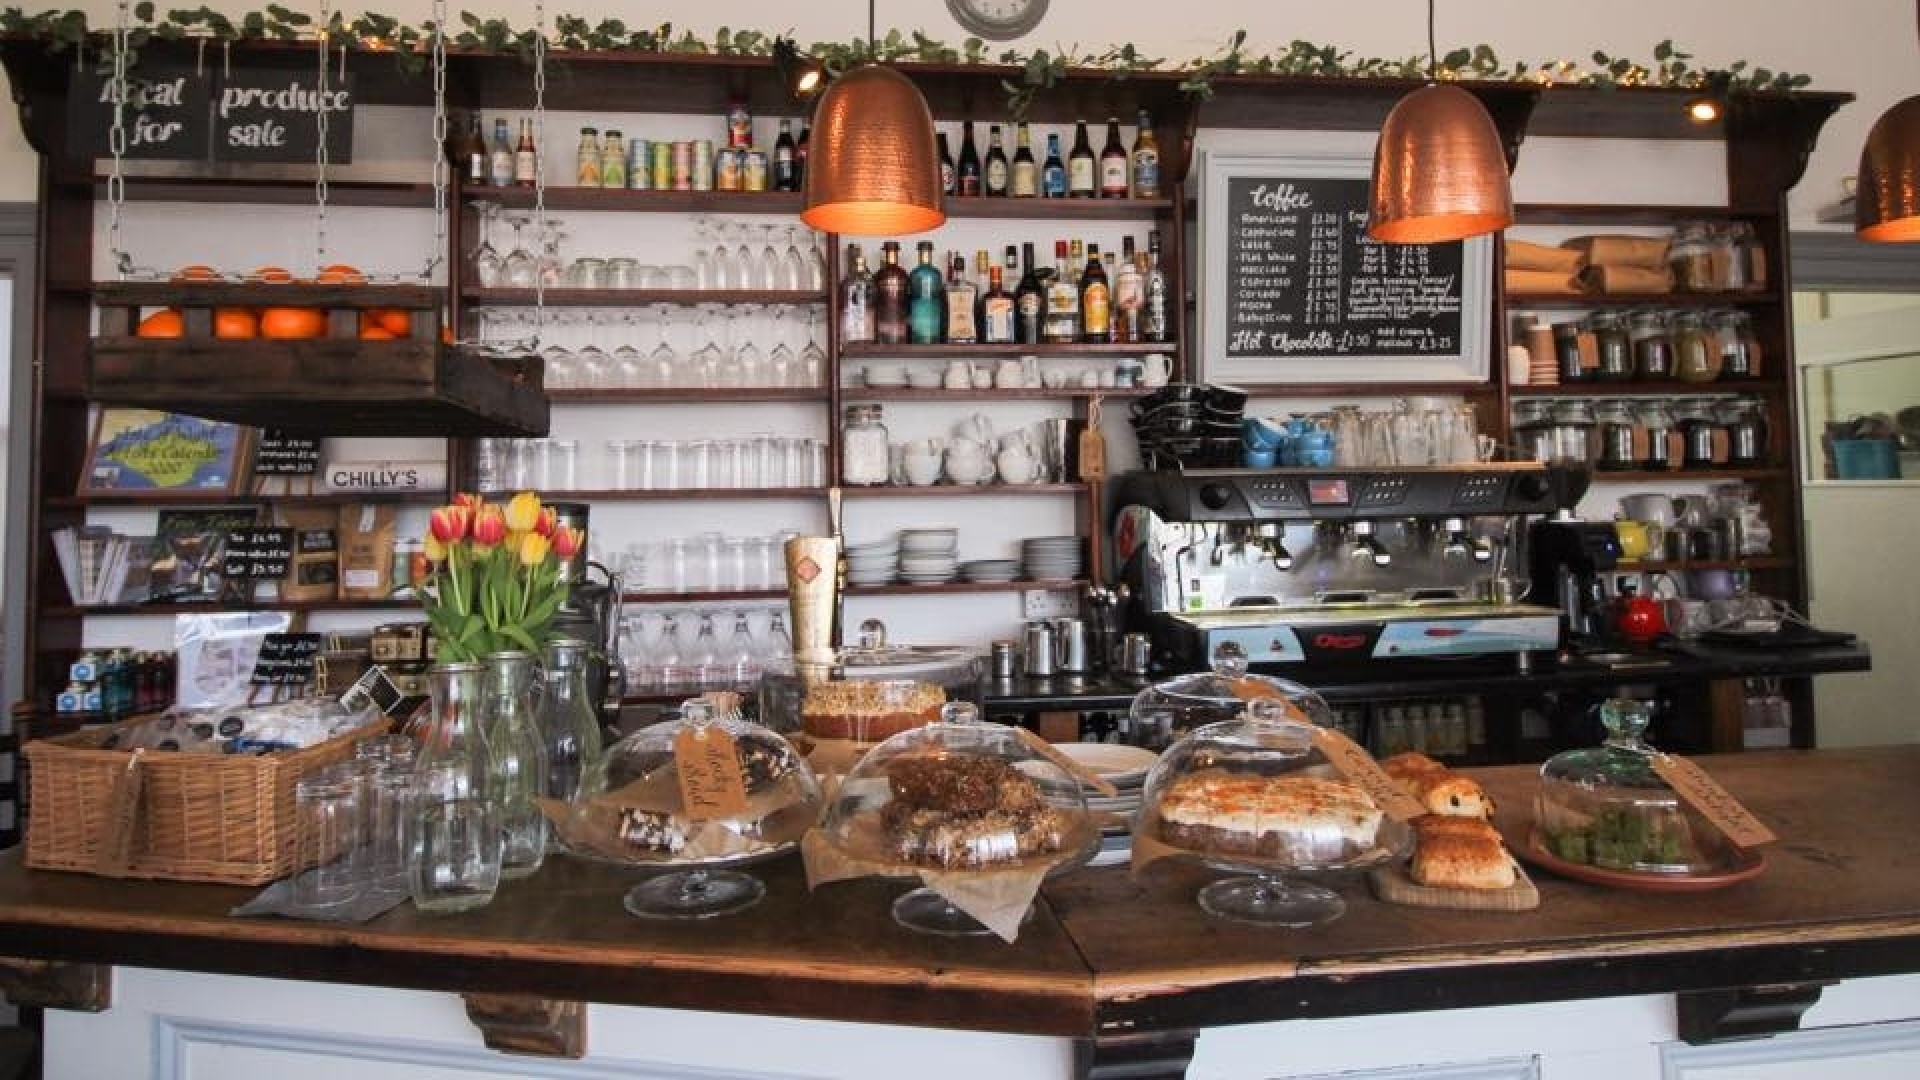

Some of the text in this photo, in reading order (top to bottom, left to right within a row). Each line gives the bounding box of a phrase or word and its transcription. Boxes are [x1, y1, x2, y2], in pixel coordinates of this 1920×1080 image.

[220, 82, 350, 119] produce
[129, 113, 183, 146] for
[227, 119, 287, 147] sale
[1250, 183, 1313, 213] Coffee
[1229, 329, 1267, 351] Hot
[1269, 330, 1334, 353] Chocolate
[333, 470, 418, 488] CHILLY'S
